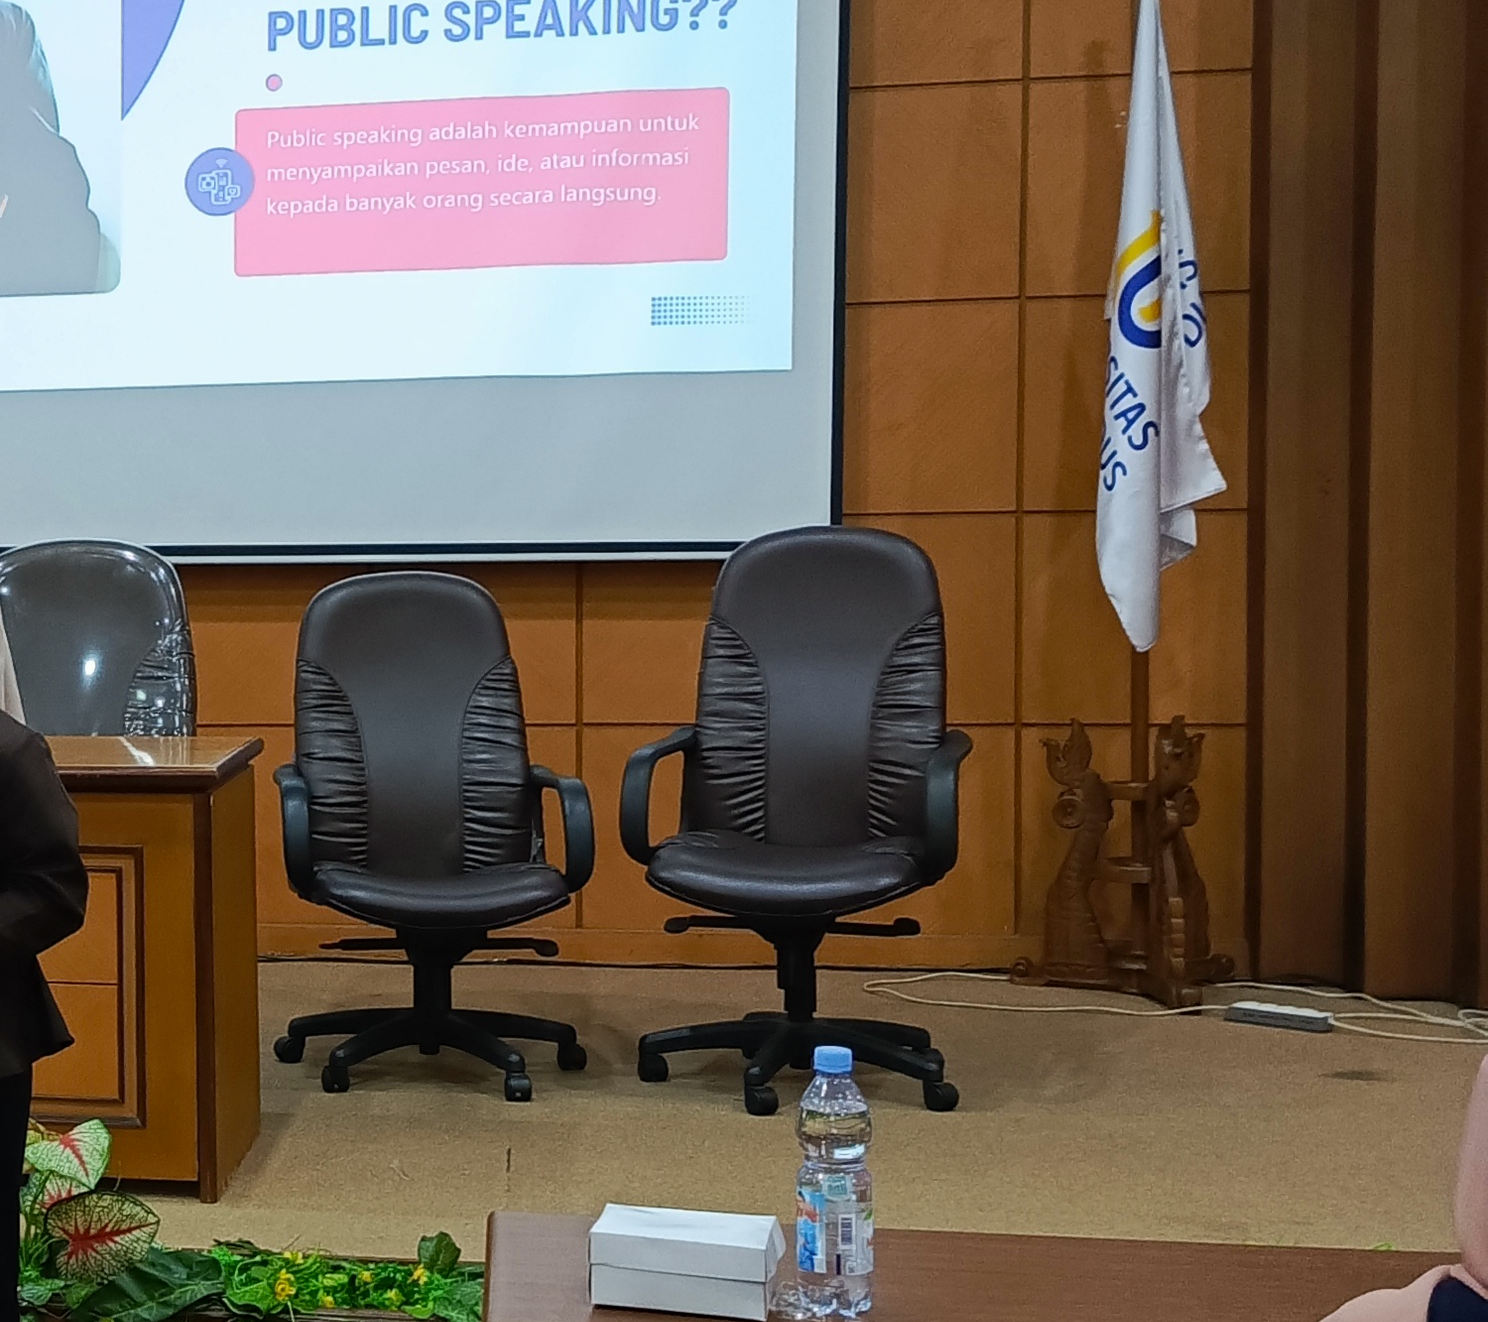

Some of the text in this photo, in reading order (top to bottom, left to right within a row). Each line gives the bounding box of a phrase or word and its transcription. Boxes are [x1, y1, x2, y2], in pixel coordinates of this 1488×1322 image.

[267, 2, 430, 52] PUBLIC
[266, 112, 700, 149] Public speaking adalah kemampuan untuk
[266, 147, 690, 185] menyampaikan pesan, ide, atau informasi
[266, 184, 662, 219] kepada banyak orang secara langsung.
